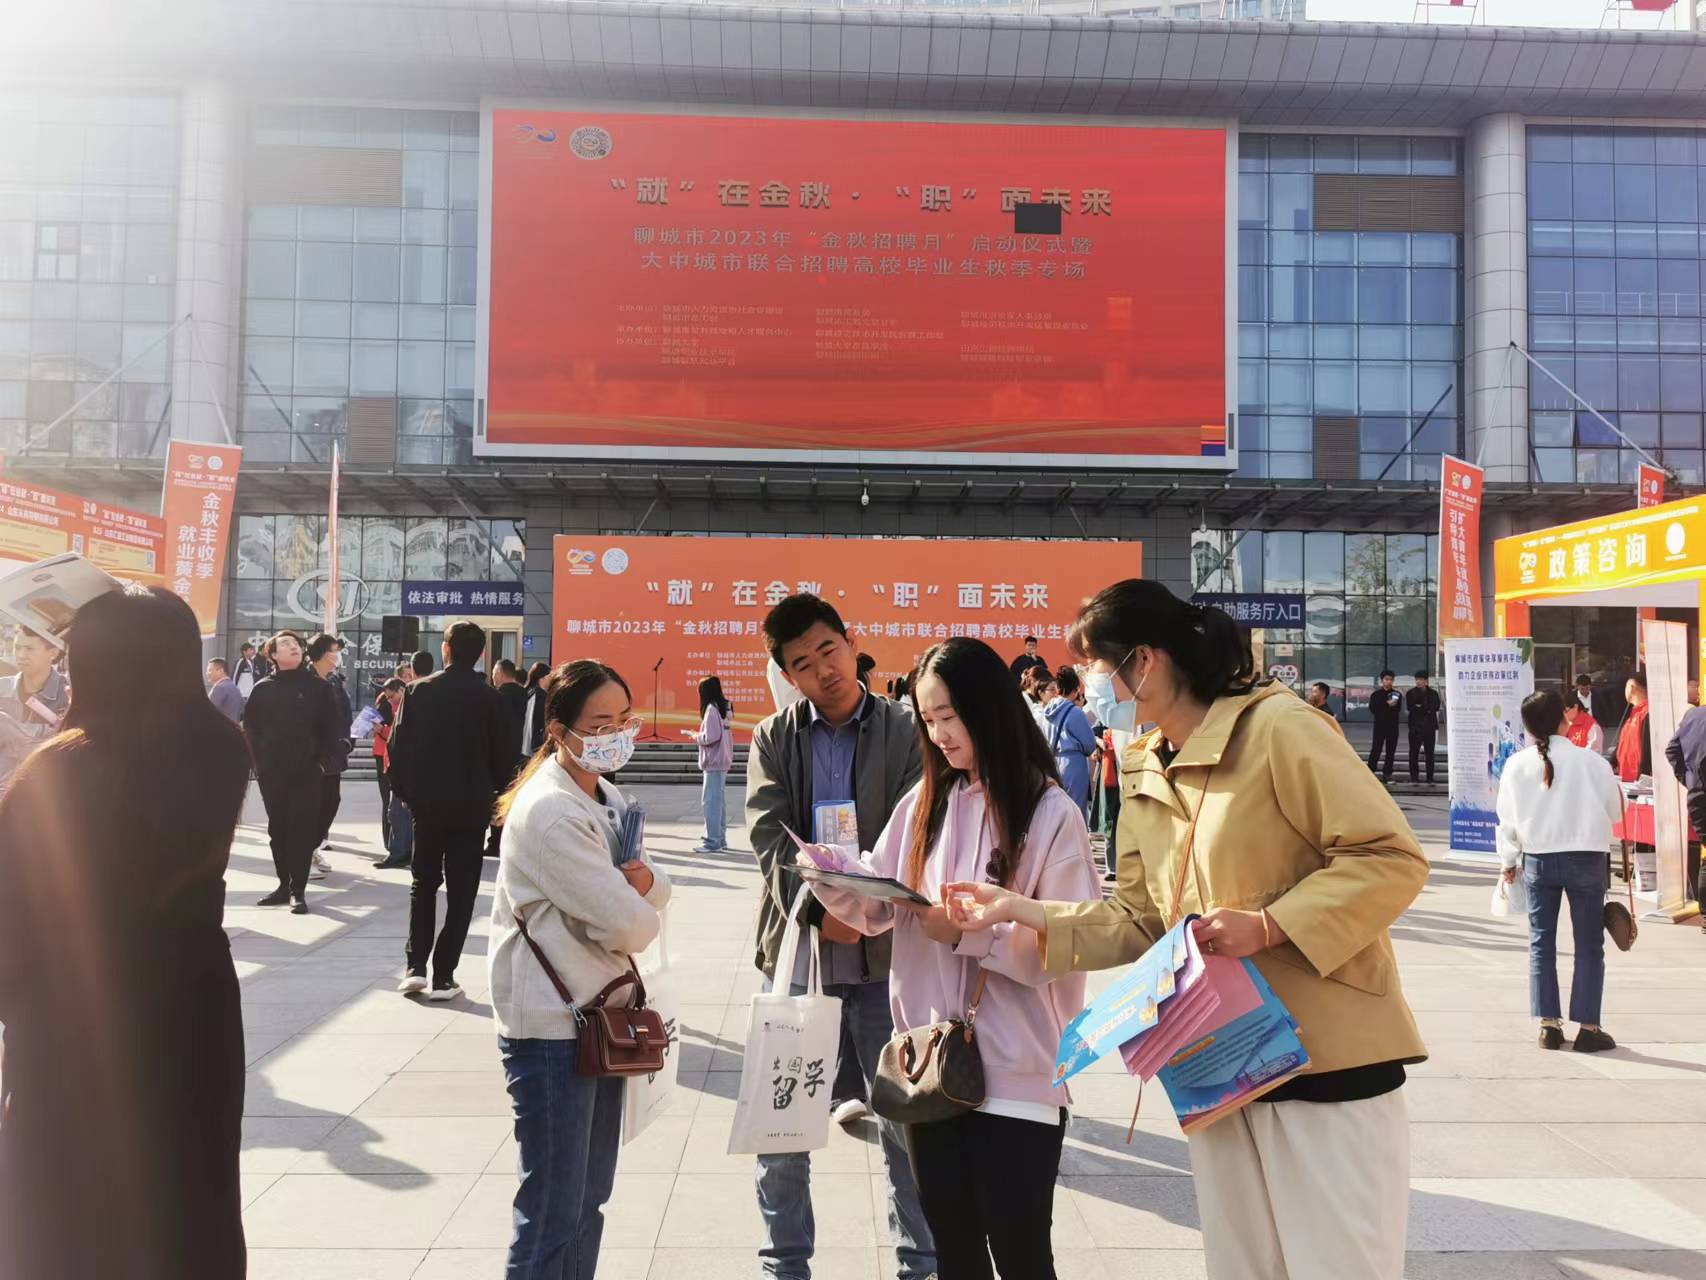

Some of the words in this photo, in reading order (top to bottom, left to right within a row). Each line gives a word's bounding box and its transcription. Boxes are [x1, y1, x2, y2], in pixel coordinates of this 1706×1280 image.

[641, 250, 1086, 281] 大中城市联合招聘高校毕业生秋季专场
[196, 491, 222, 580] 金秋丰收季
[1548, 533, 1647, 579] 政策咨询
[172, 524, 198, 603] 就业黄金
[407, 590, 463, 605] 依法审批
[470, 591, 524, 606] 热情服务
